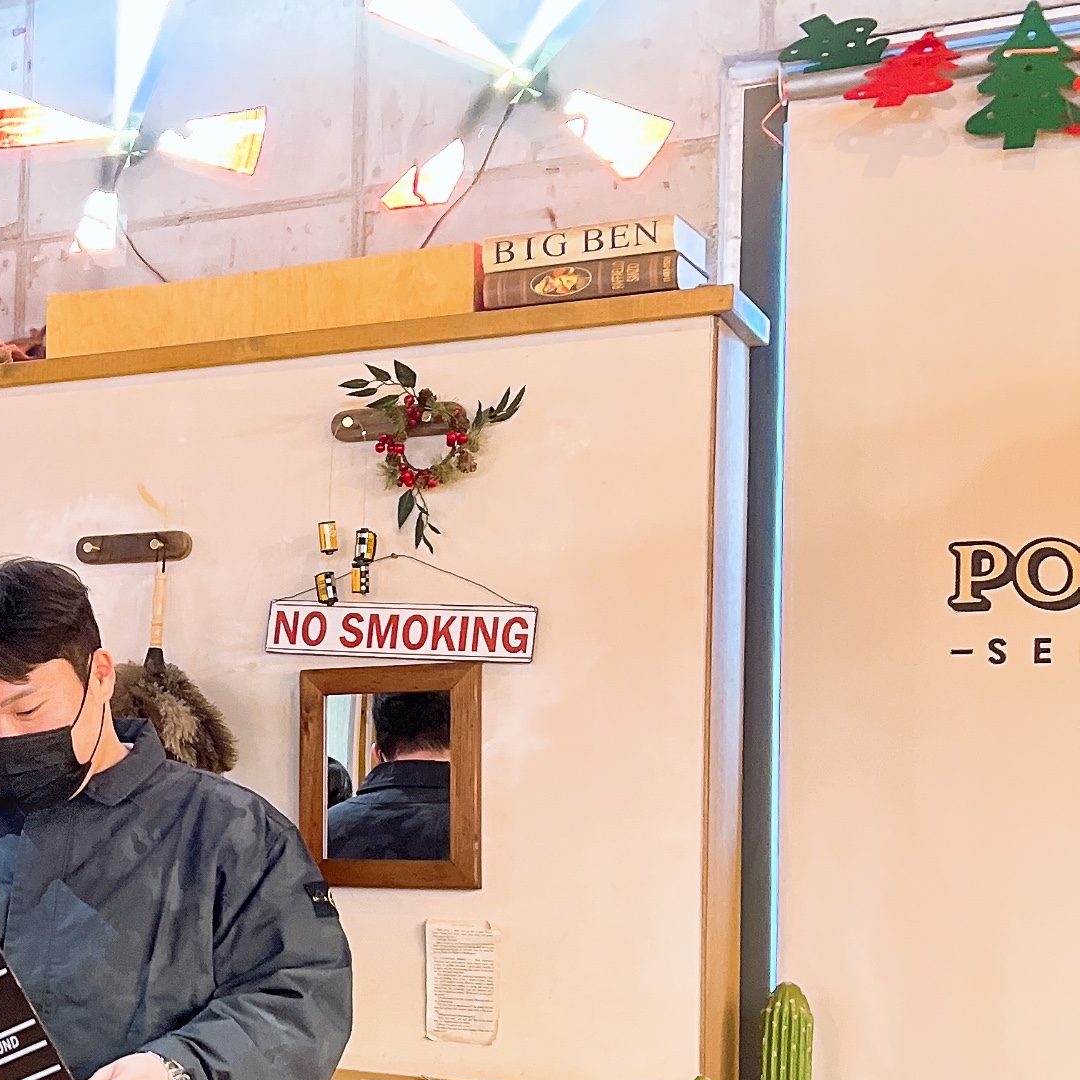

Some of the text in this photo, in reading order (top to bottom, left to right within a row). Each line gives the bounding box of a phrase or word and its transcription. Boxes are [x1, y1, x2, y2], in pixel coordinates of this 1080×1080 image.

[493, 219, 661, 265] BIG BEN
[273, 610, 530, 654] NO SMOKING
